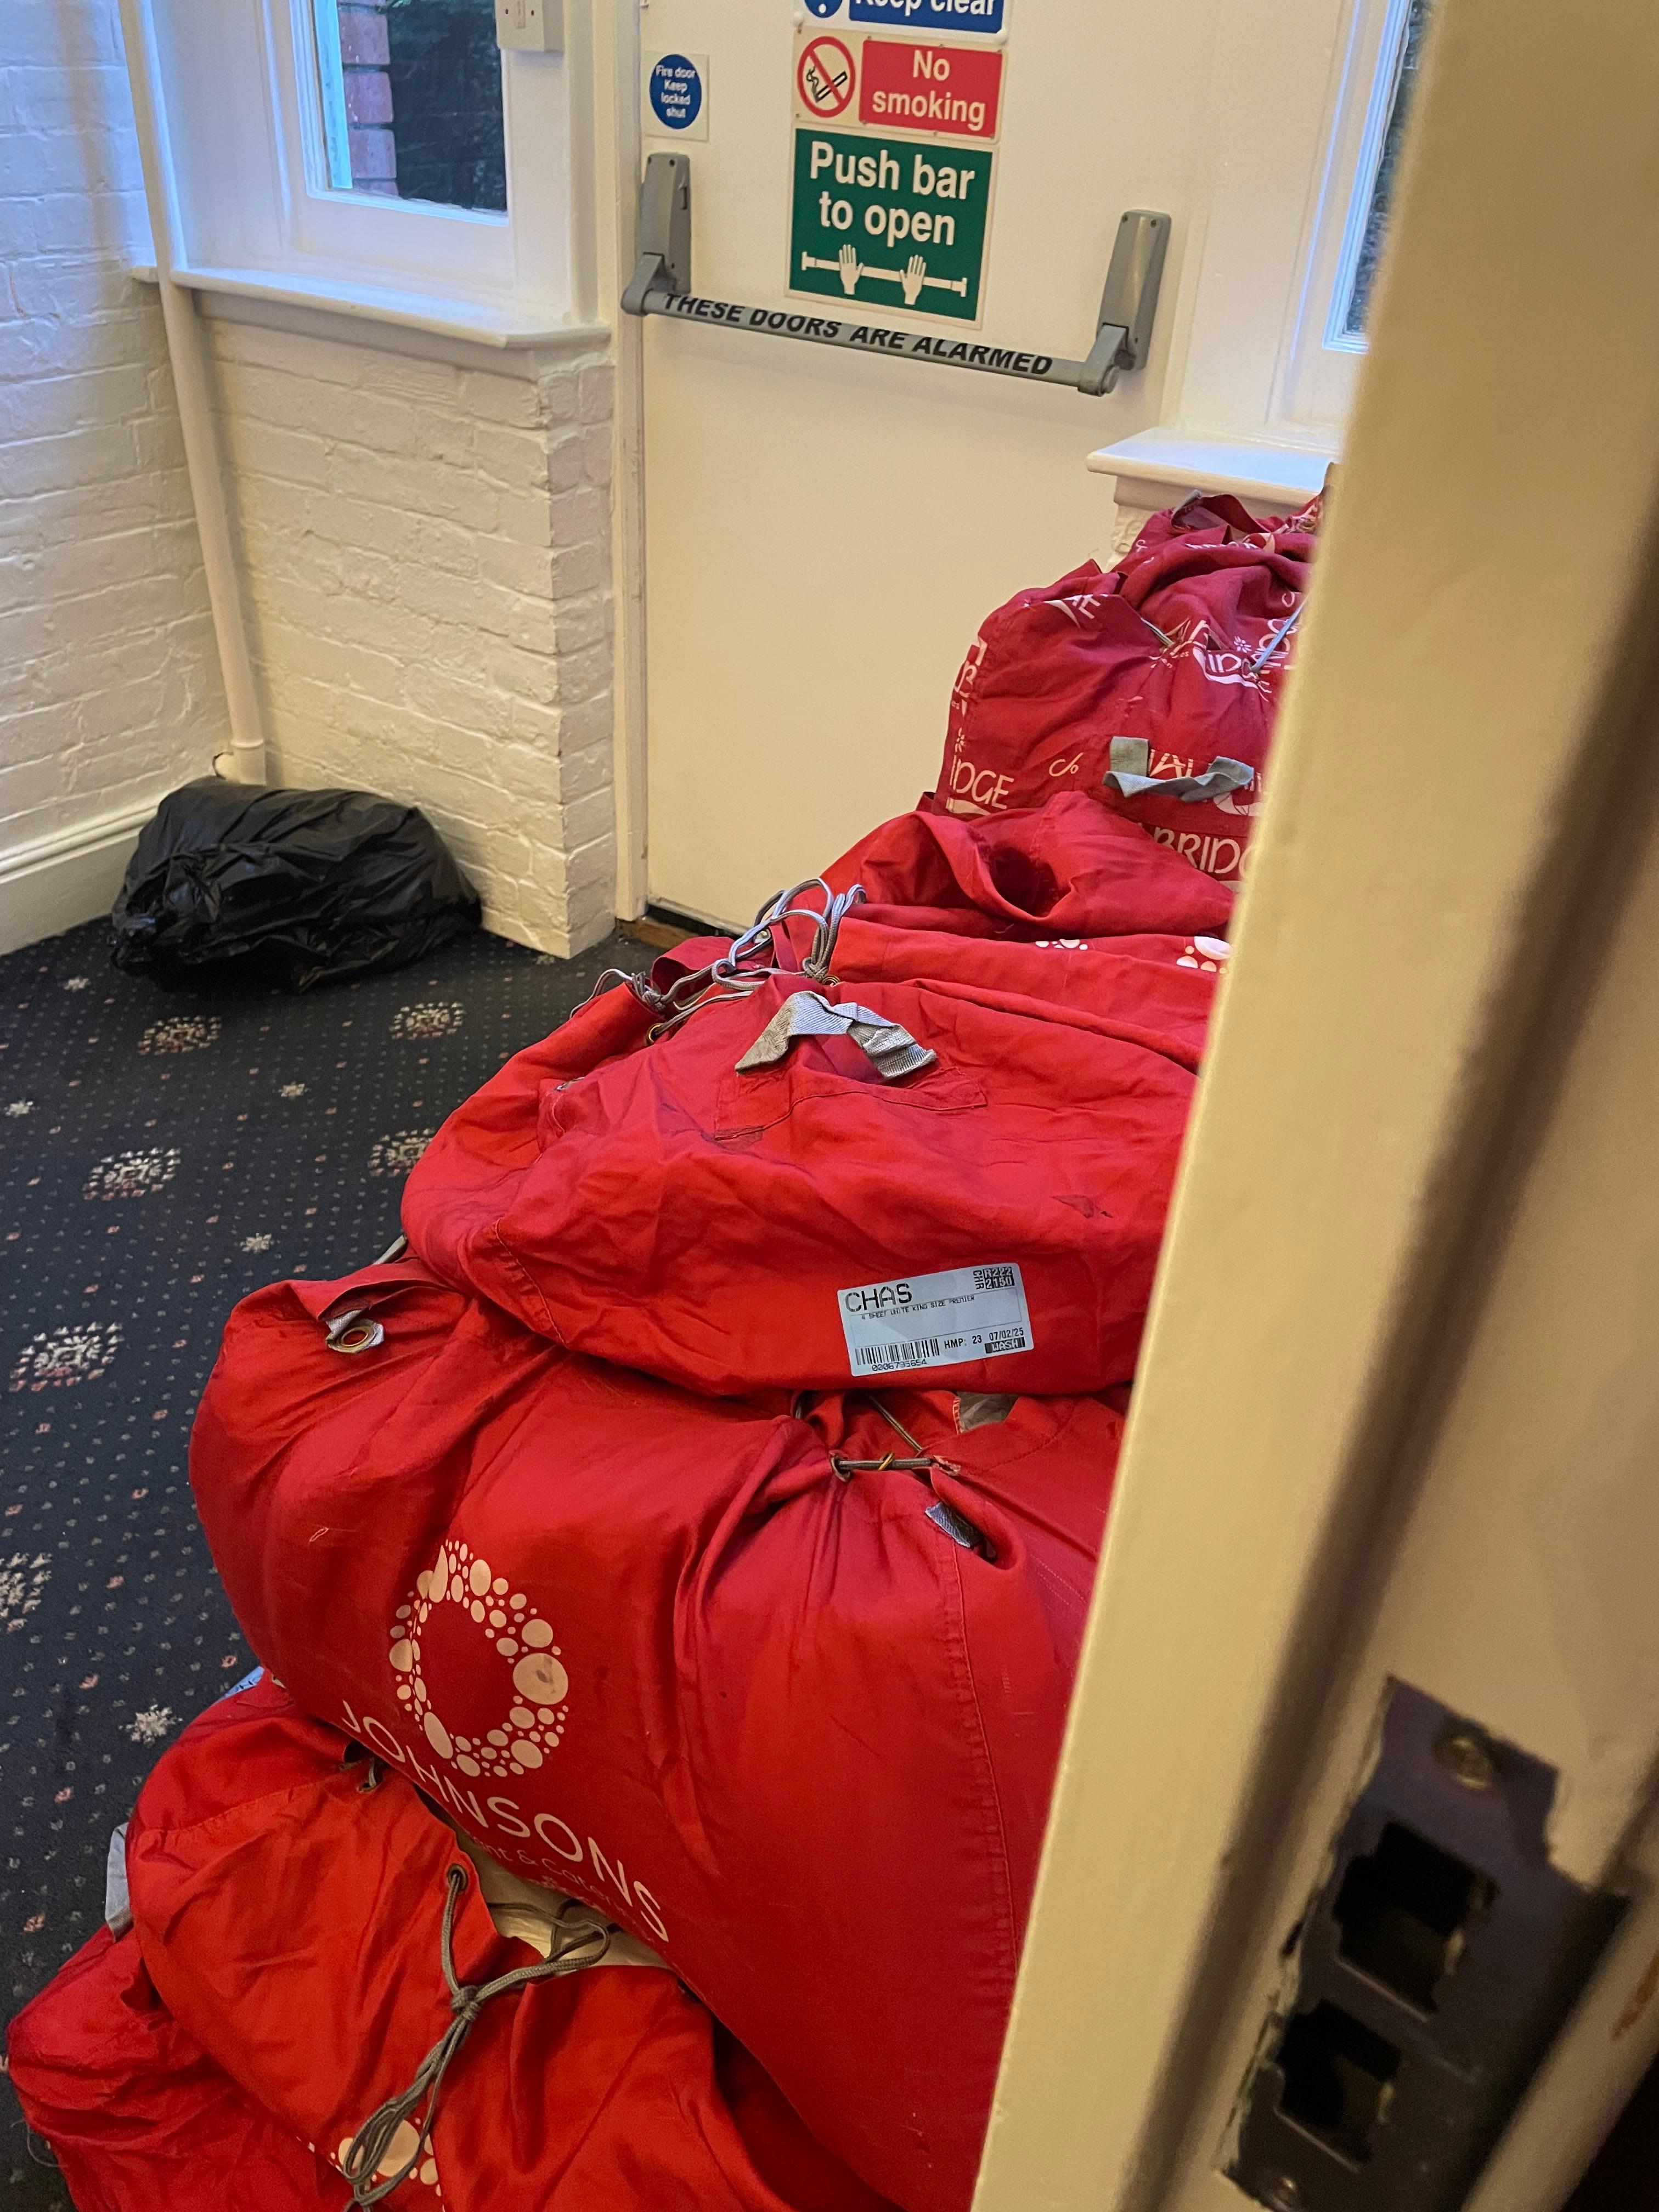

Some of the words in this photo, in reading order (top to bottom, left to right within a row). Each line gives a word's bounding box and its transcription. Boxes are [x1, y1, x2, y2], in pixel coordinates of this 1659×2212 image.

[656, 65, 673, 77] Fire
[674, 67, 696, 78] door
[913, 50, 950, 81] No
[661, 92, 691, 105] locked
[664, 78, 687, 94] Keep
[666, 107, 686, 118] shut
[872, 91, 985, 131] smoking
[810, 140, 900, 190] Push
[913, 154, 975, 200] bar
[819, 191, 853, 230] to
[864, 205, 955, 247] open
[664, 293, 745, 323] THESE
[749, 308, 842, 338] DOORS
[850, 326, 909, 349] ARE
[911, 336, 1053, 375] ALARMED
[845, 1283, 912, 1312] CHAS
[930, 1300, 946, 1308] SIZE
[949, 1295, 975, 1304] PREMIER
[944, 1337, 967, 1350] HMP:
[972, 1334, 983, 1344] 23
[988, 1327, 1024, 1341] 07/02/25
[991, 1338, 1019, 1351] WASH
[342, 1700, 669, 1943] JOHNSONS
